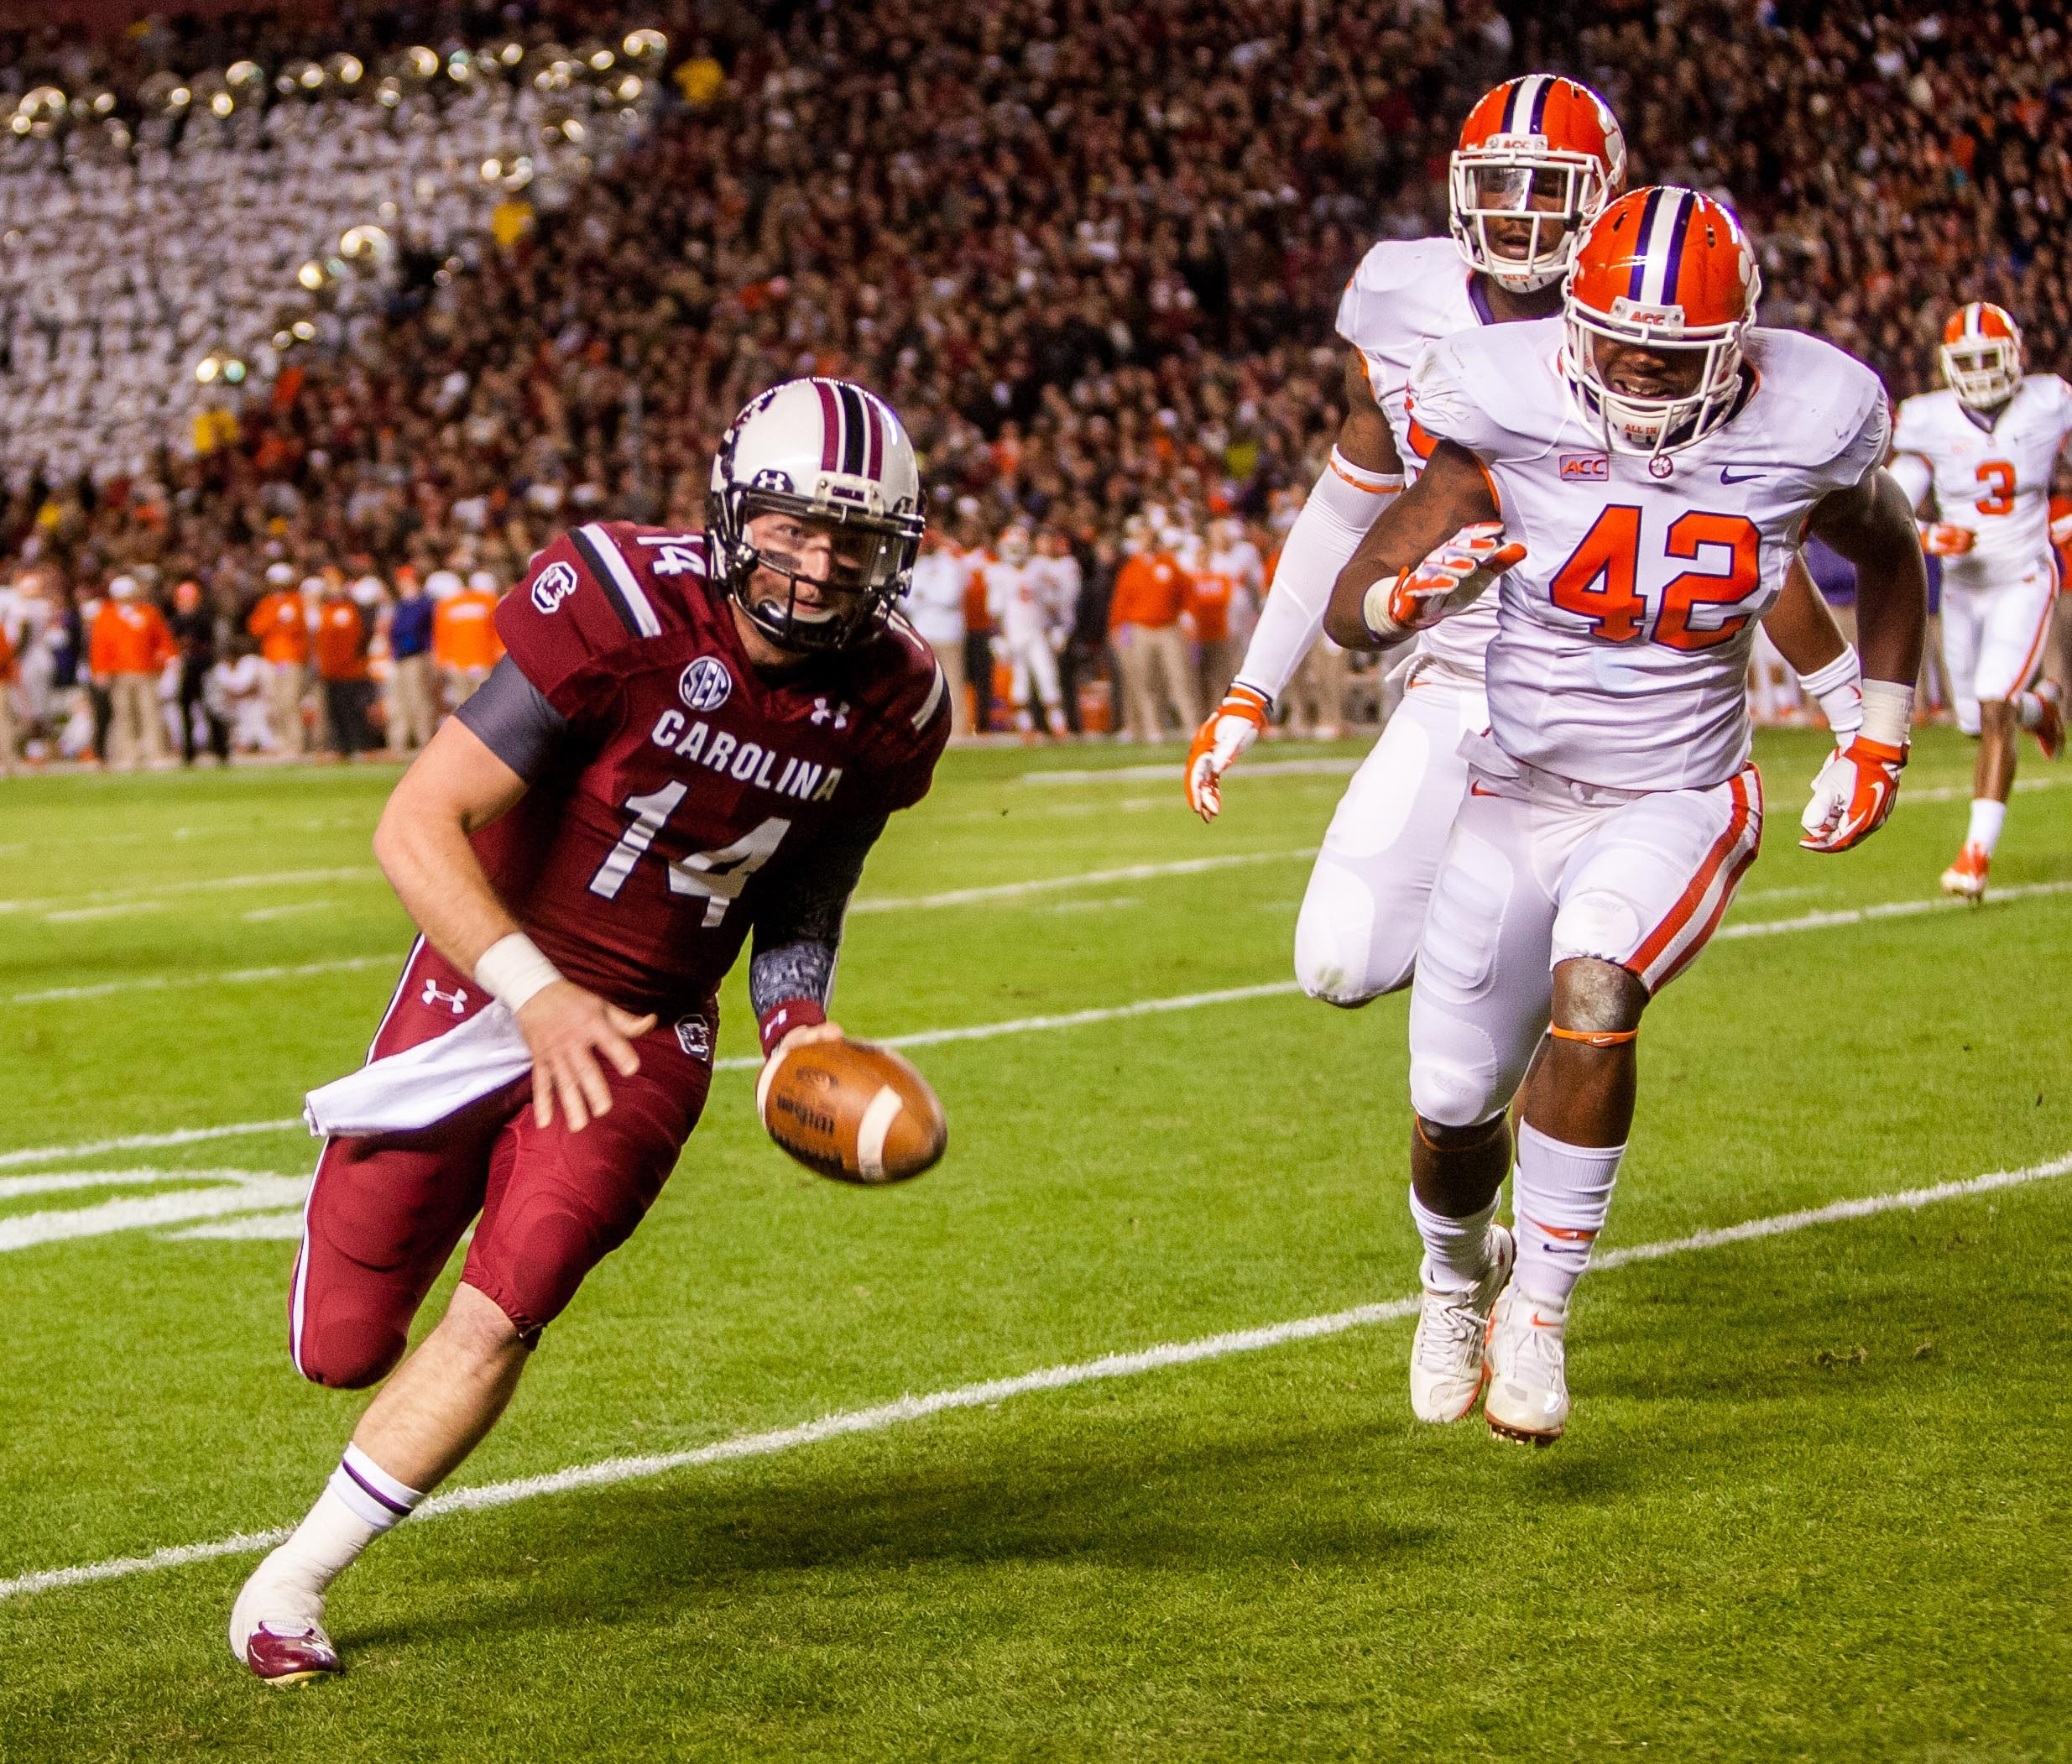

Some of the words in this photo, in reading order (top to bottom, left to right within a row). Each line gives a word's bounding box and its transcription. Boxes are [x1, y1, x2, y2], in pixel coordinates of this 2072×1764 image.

[1630, 311, 1666, 326] ACC
[1625, 423, 1642, 434] ALL
[1646, 426, 1657, 435] IN
[1563, 459, 1606, 475] ACC
[1975, 460, 2015, 516] 3
[636, 534, 707, 578] 14
[1549, 504, 1761, 651] 42
[684, 661, 727, 707] SEC
[652, 710, 843, 802] CAROLINA
[589, 780, 791, 927] 14
